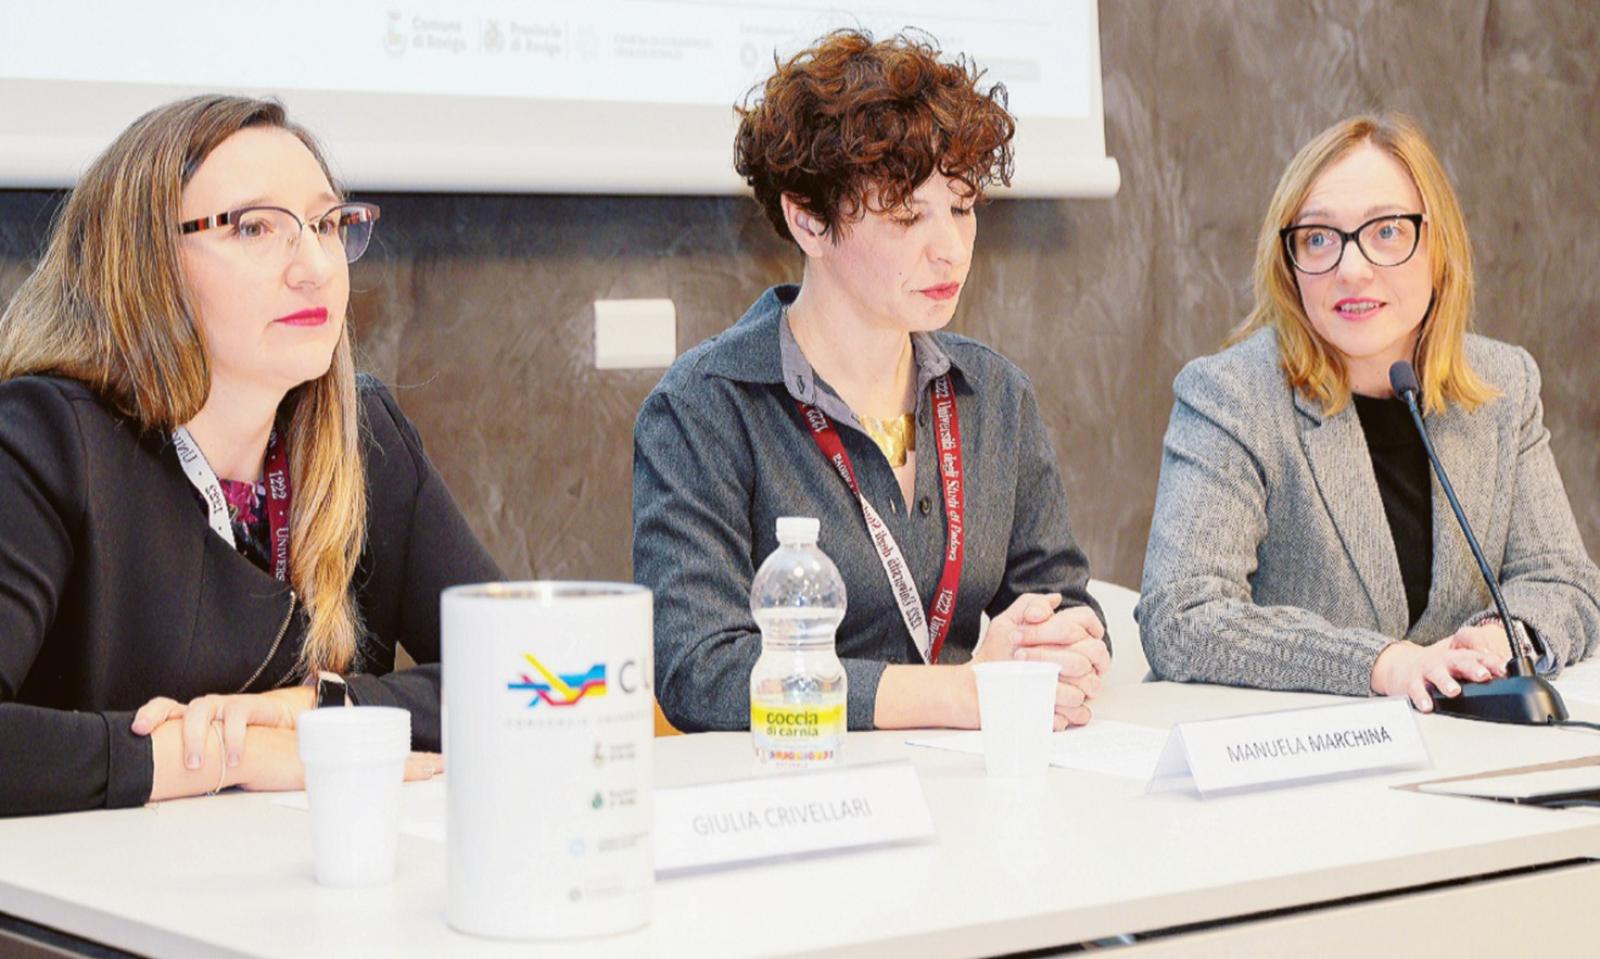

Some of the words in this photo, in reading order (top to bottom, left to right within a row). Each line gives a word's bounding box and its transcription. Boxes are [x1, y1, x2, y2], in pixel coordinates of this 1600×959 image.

[269, 470, 287, 499] 1222
[1226, 736, 1308, 763] MANUELA
[1307, 726, 1392, 753] MARCHINA
[691, 810, 762, 837] GIULIA
[763, 797, 873, 828] CRIVELLARI
